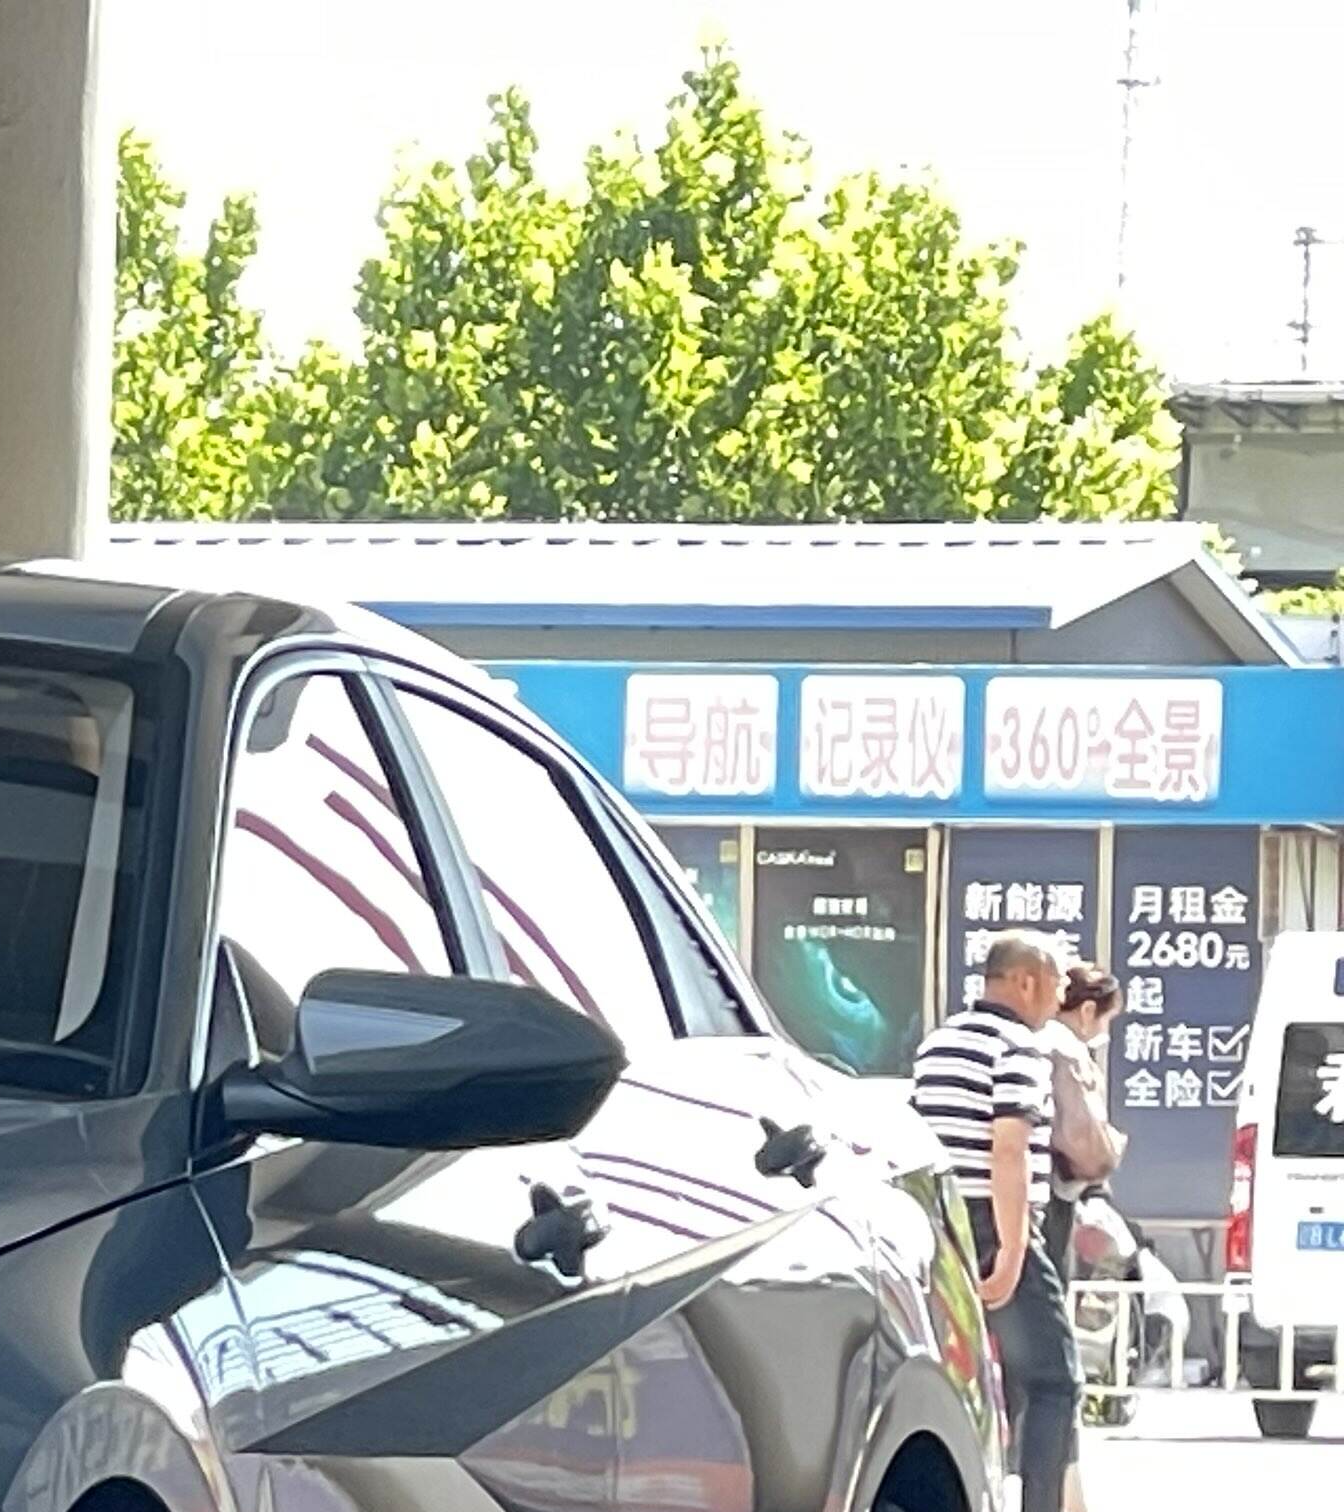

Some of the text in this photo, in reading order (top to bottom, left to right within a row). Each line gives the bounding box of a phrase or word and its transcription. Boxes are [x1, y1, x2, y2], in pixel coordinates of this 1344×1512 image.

[639, 696, 762, 788] 导航
[814, 697, 950, 790] 记录仪
[965, 881, 1084, 922] 新能源
[1128, 885, 1249, 924] 月租金
[1126, 931, 1251, 970] 2680元
[1126, 975, 1165, 1014] 起
[1124, 1022, 1204, 1063] 新车
[1124, 1068, 1203, 1108] 全险
